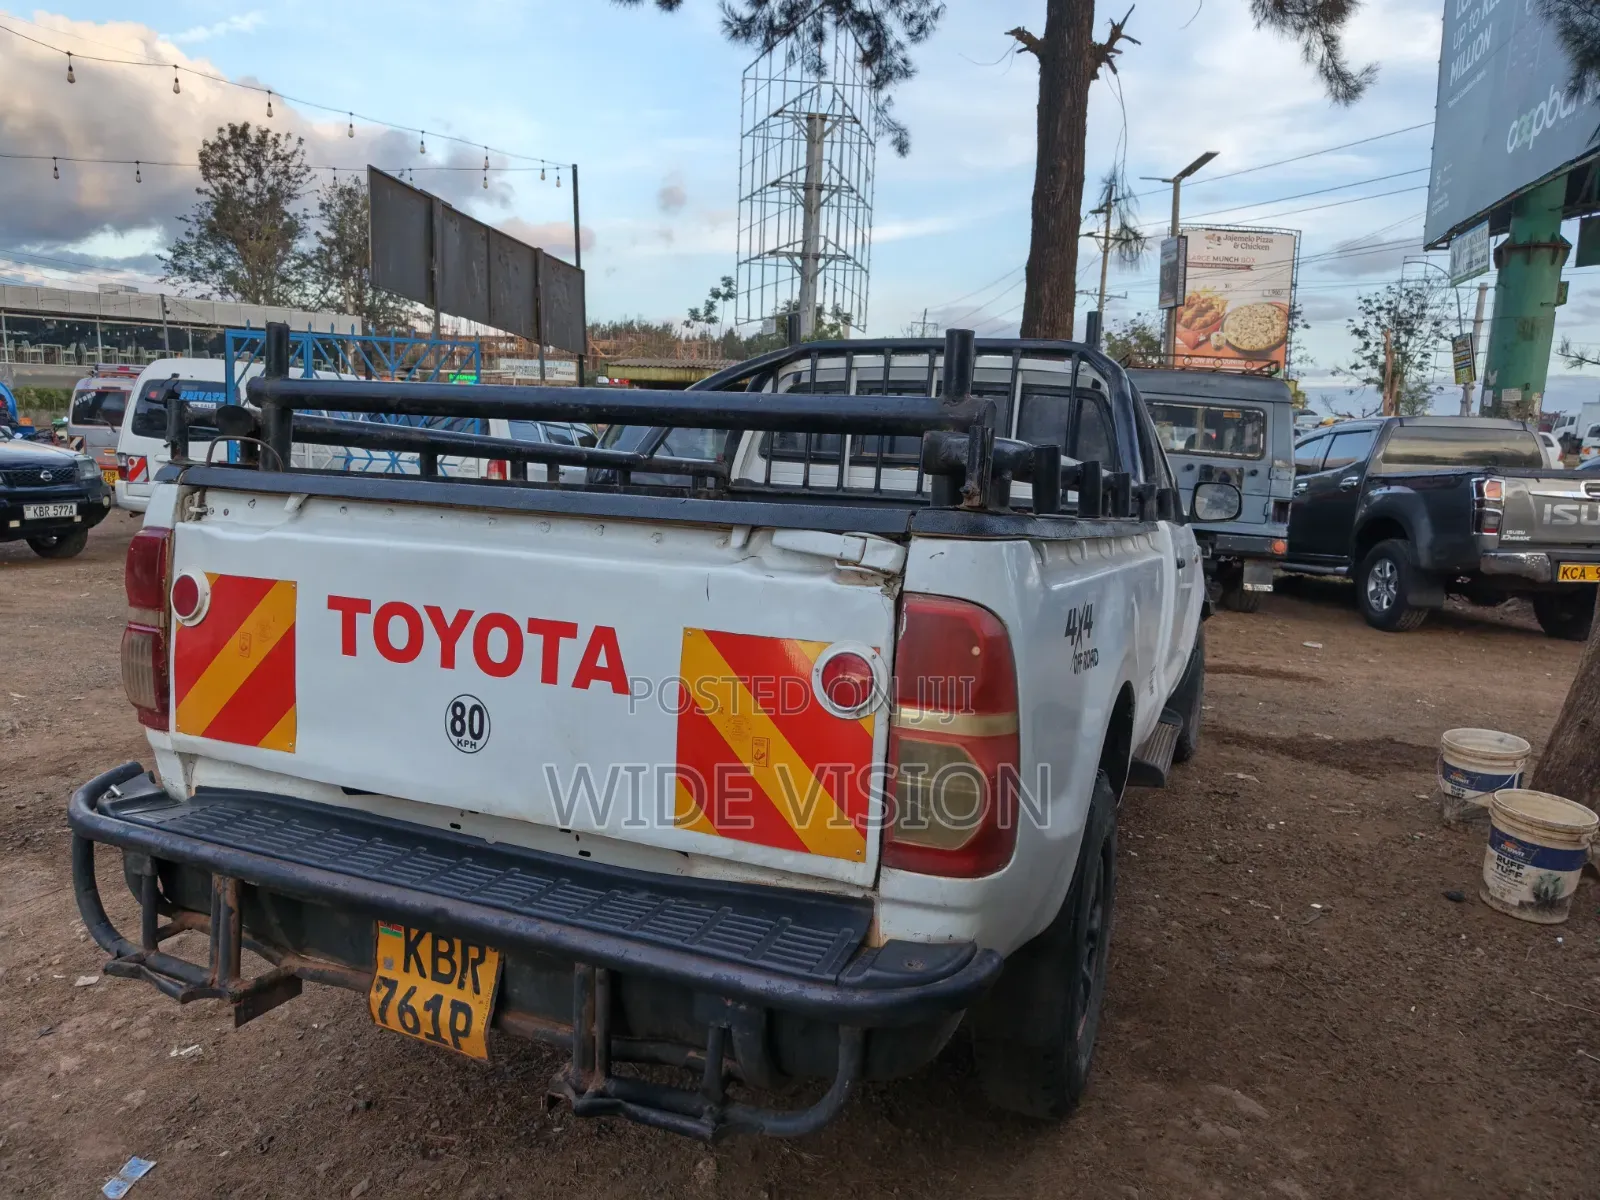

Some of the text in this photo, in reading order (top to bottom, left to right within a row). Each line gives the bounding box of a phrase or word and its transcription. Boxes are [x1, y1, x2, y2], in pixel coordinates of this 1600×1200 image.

[1453, 0, 1501, 52] up to KE
[1449, 24, 1493, 87] MILLION
[1240, 242, 1270, 251] Chicken
[1256, 235, 1273, 244] Pizza
[1212, 255, 1239, 263] MUNCH
[180, 391, 226, 402] PRIVATE
[33, 504, 74, 518] KBR 577A
[1562, 566, 1586, 580] KCA
[327, 594, 632, 696] TOYOTA
[450, 701, 485, 741] 80
[456, 738, 477, 750] KPH
[1496, 854, 1525, 871] RUFF
[1496, 862, 1523, 879] TUFF
[403, 925, 487, 996] KBR
[376, 975, 474, 1051] 761P
